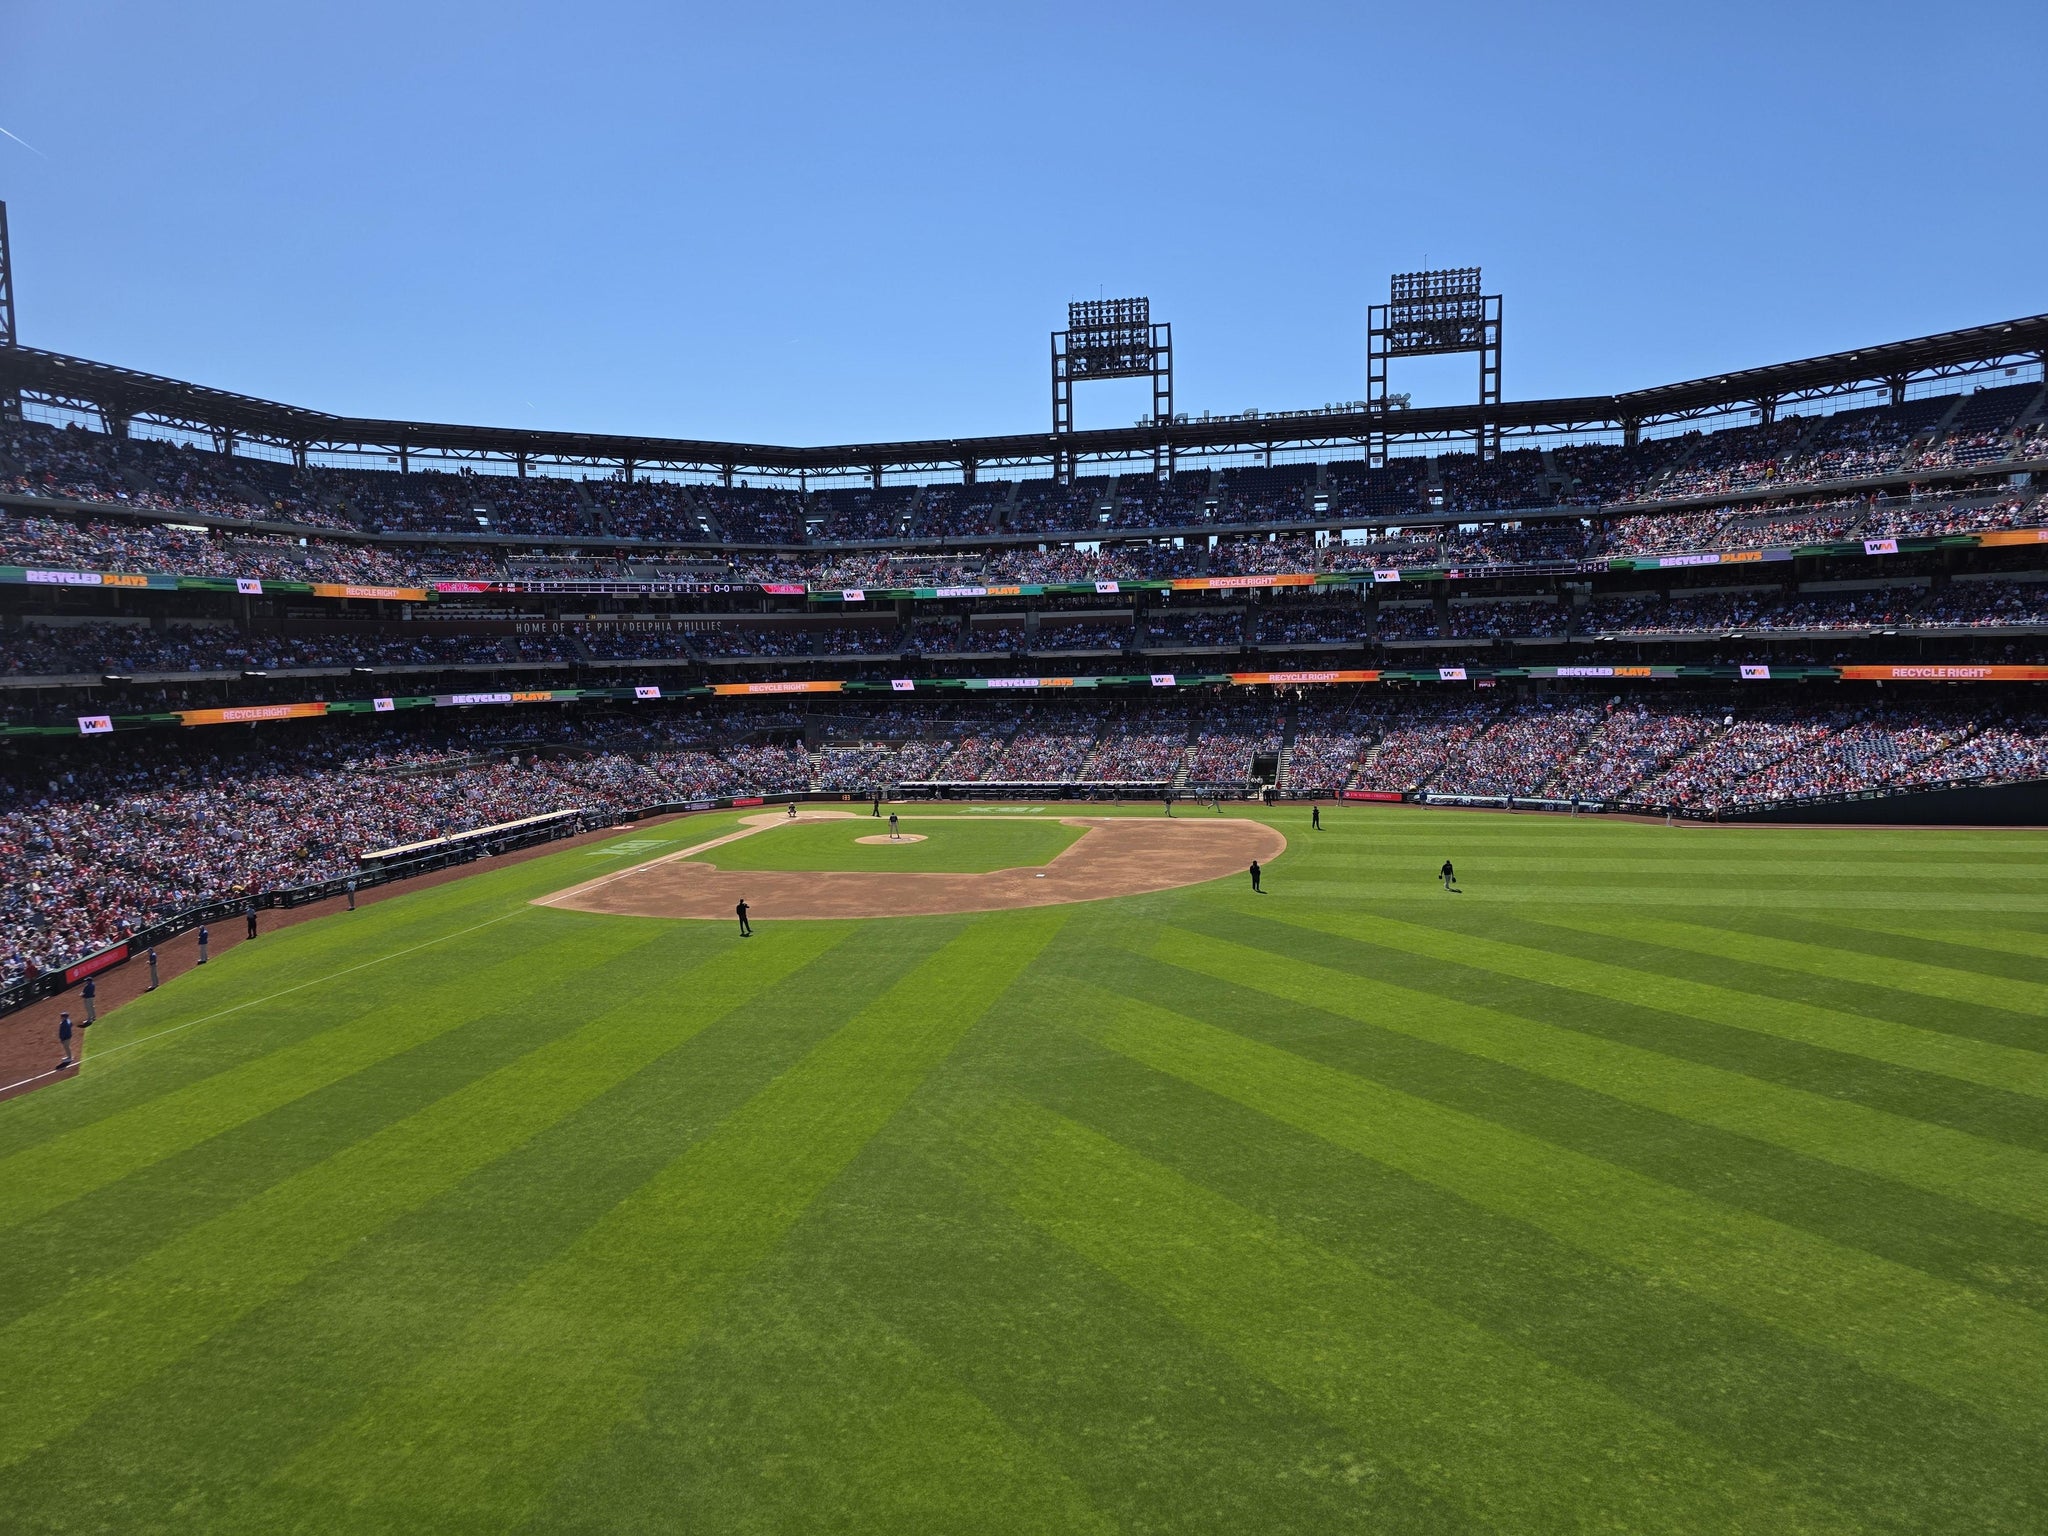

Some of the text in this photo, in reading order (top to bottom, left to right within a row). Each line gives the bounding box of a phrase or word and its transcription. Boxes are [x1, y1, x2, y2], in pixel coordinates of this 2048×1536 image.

[1659, 551, 1762, 566] RECYCLED PLAYS
[26, 570, 148, 586] RECYCLED PLAYS
[1209, 579, 1247, 587] RECYCLE
[345, 587, 378, 597] RECYCLE
[936, 586, 1020, 596] RECYCLED PLAYS
[516, 622, 547, 633] HOME
[552, 622, 565, 632] OF
[597, 621, 672, 632] PHLADELPHIA
[678, 621, 722, 631] PHILLIES
[1557, 667, 1652, 676] RECYCLED PLAYS
[1891, 668, 1946, 678] RECYCLE
[987, 679, 1074, 687] RECYCLED PLAYS
[1268, 674, 1309, 682] RECYCLE
[452, 691, 552, 704] RECYCLED PLAYS
[223, 709, 262, 721] RECYCLE
[84, 720, 107, 729] WM
